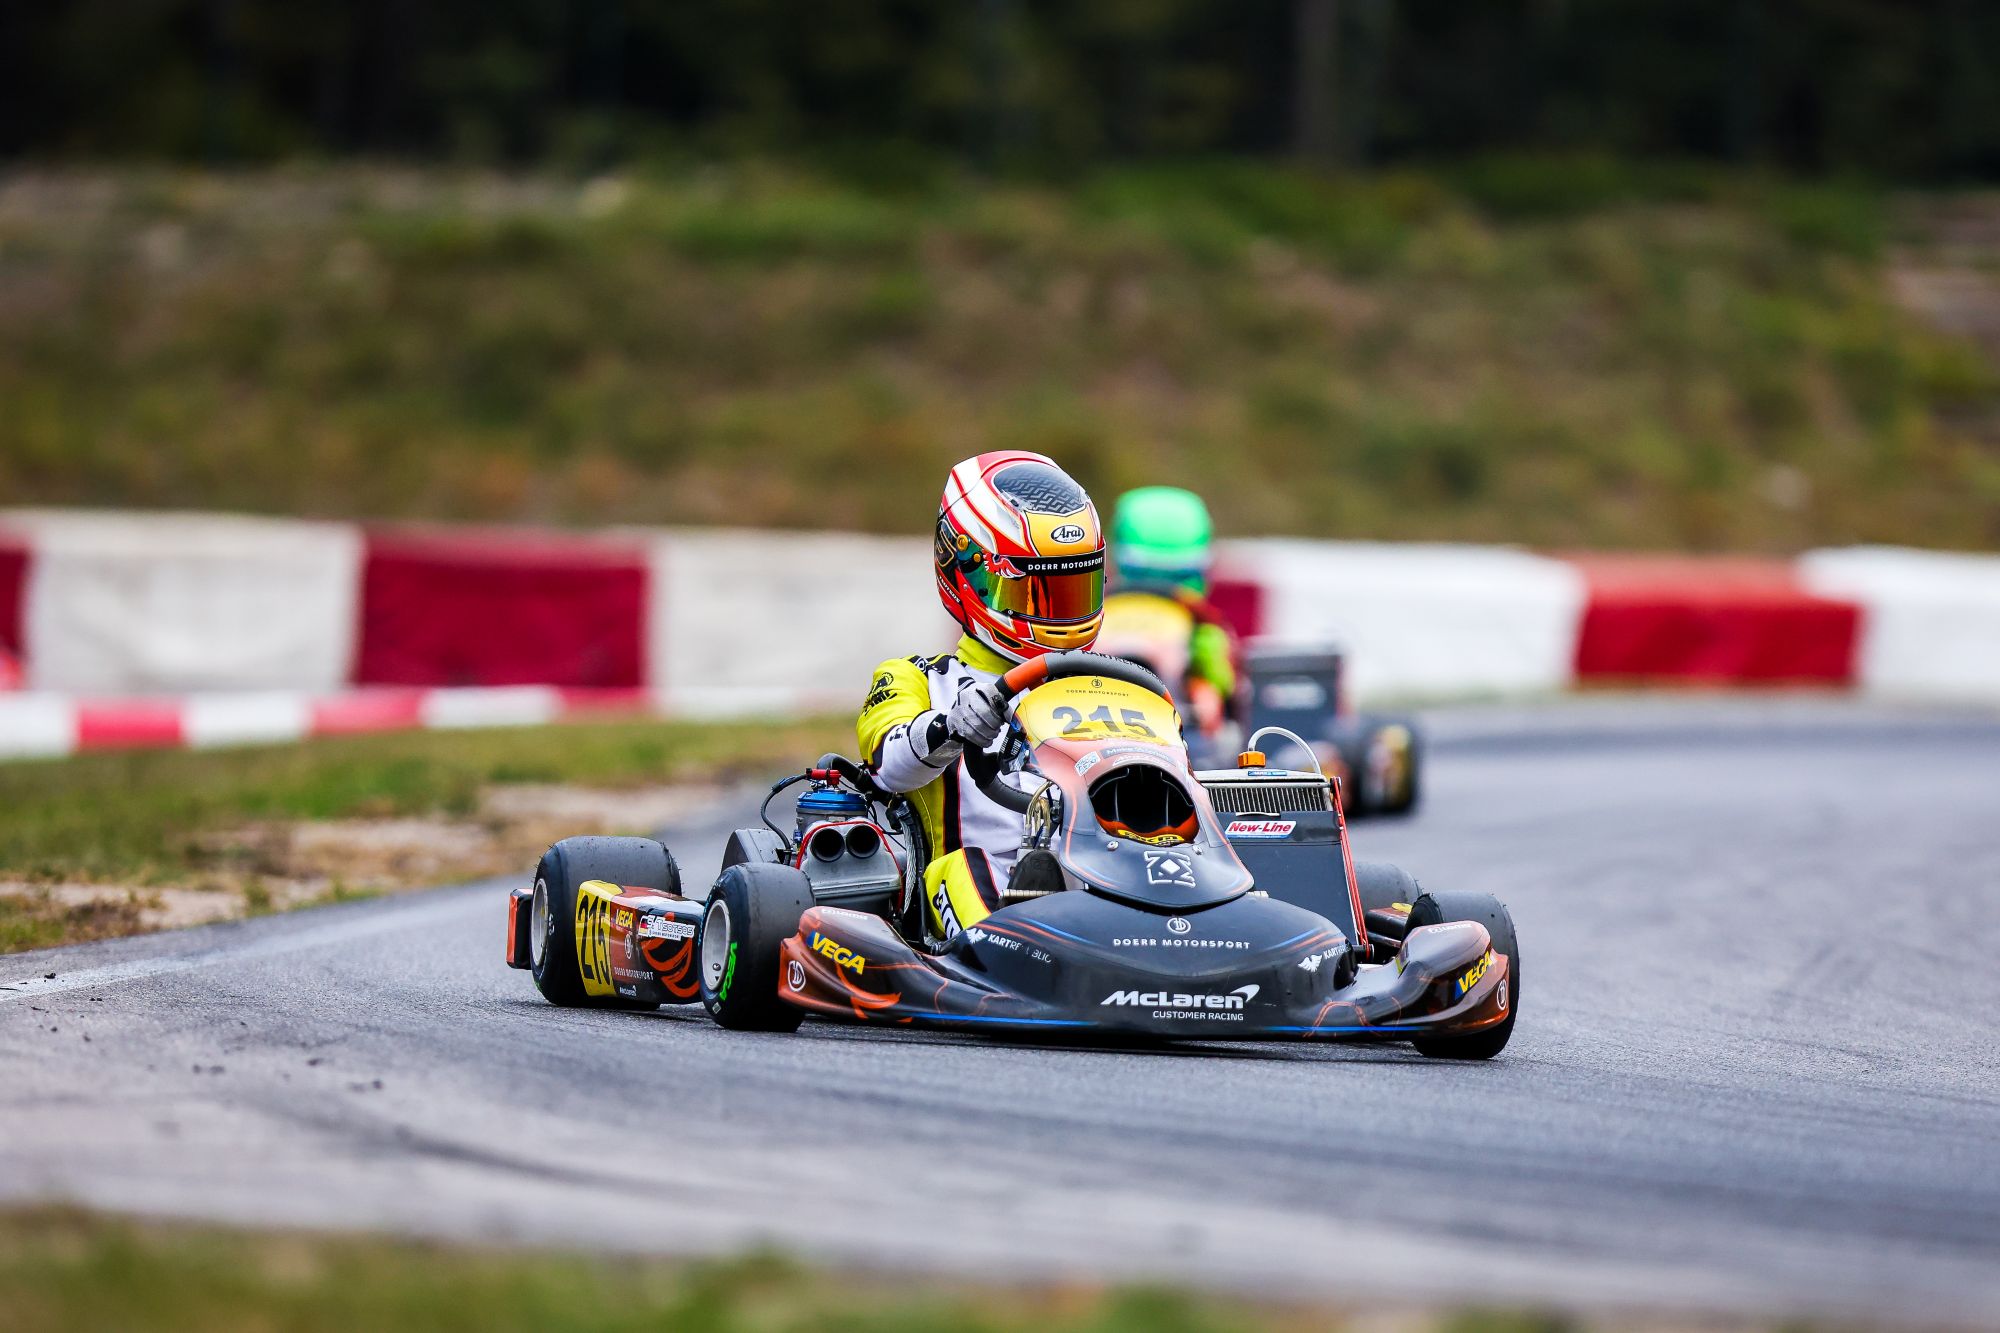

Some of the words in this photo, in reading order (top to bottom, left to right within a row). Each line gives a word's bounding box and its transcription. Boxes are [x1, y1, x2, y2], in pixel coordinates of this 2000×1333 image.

[1054, 525, 1081, 540] Arai
[1028, 563, 1058, 571] DOERR
[1061, 556, 1103, 570] MOTORSPORT
[1052, 705, 1157, 738] 215
[1228, 822, 1292, 832] New-Line
[615, 908, 634, 929] VEGA
[578, 894, 611, 986] 215
[1113, 938, 1157, 947] DOERR
[1162, 939, 1250, 950] MOTORSPORT
[812, 931, 866, 976] VEGA
[1458, 950, 1494, 993] VEGA
[1100, 990, 1244, 1009] McLaren
[1153, 1010, 1206, 1020] CUSTOMER
[1208, 1013, 1244, 1021] RACING
